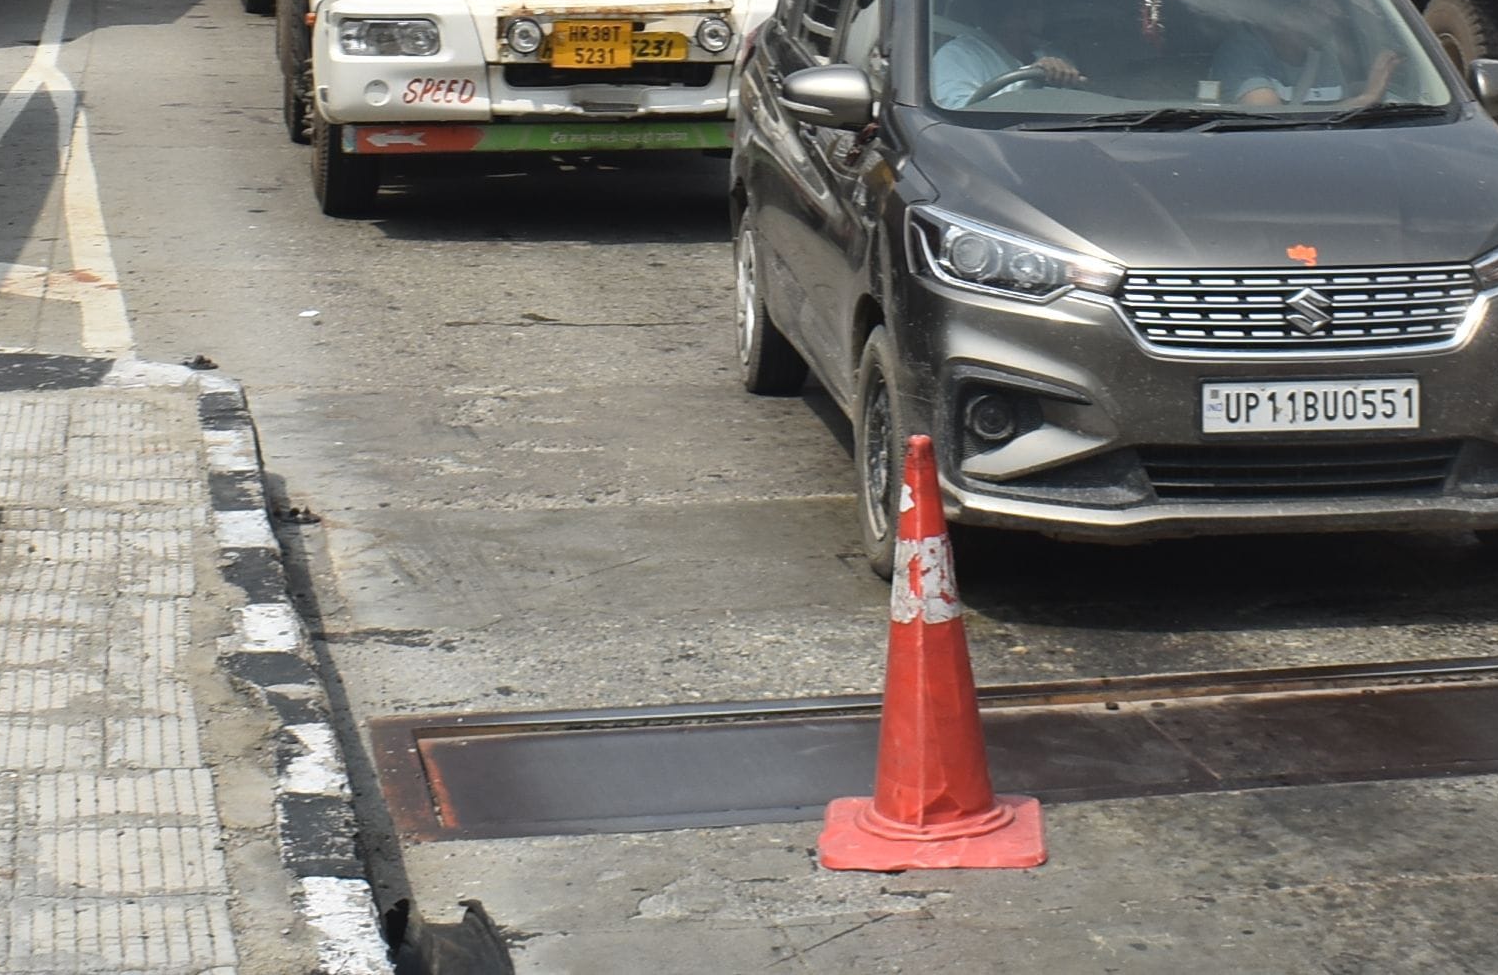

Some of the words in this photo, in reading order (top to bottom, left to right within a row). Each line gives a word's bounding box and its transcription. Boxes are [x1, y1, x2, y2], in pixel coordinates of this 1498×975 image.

[568, 25, 622, 43] HR38T
[574, 47, 616, 65] 5231
[402, 77, 476, 104] SPEED
[1224, 387, 1414, 424] UP11BU0551
